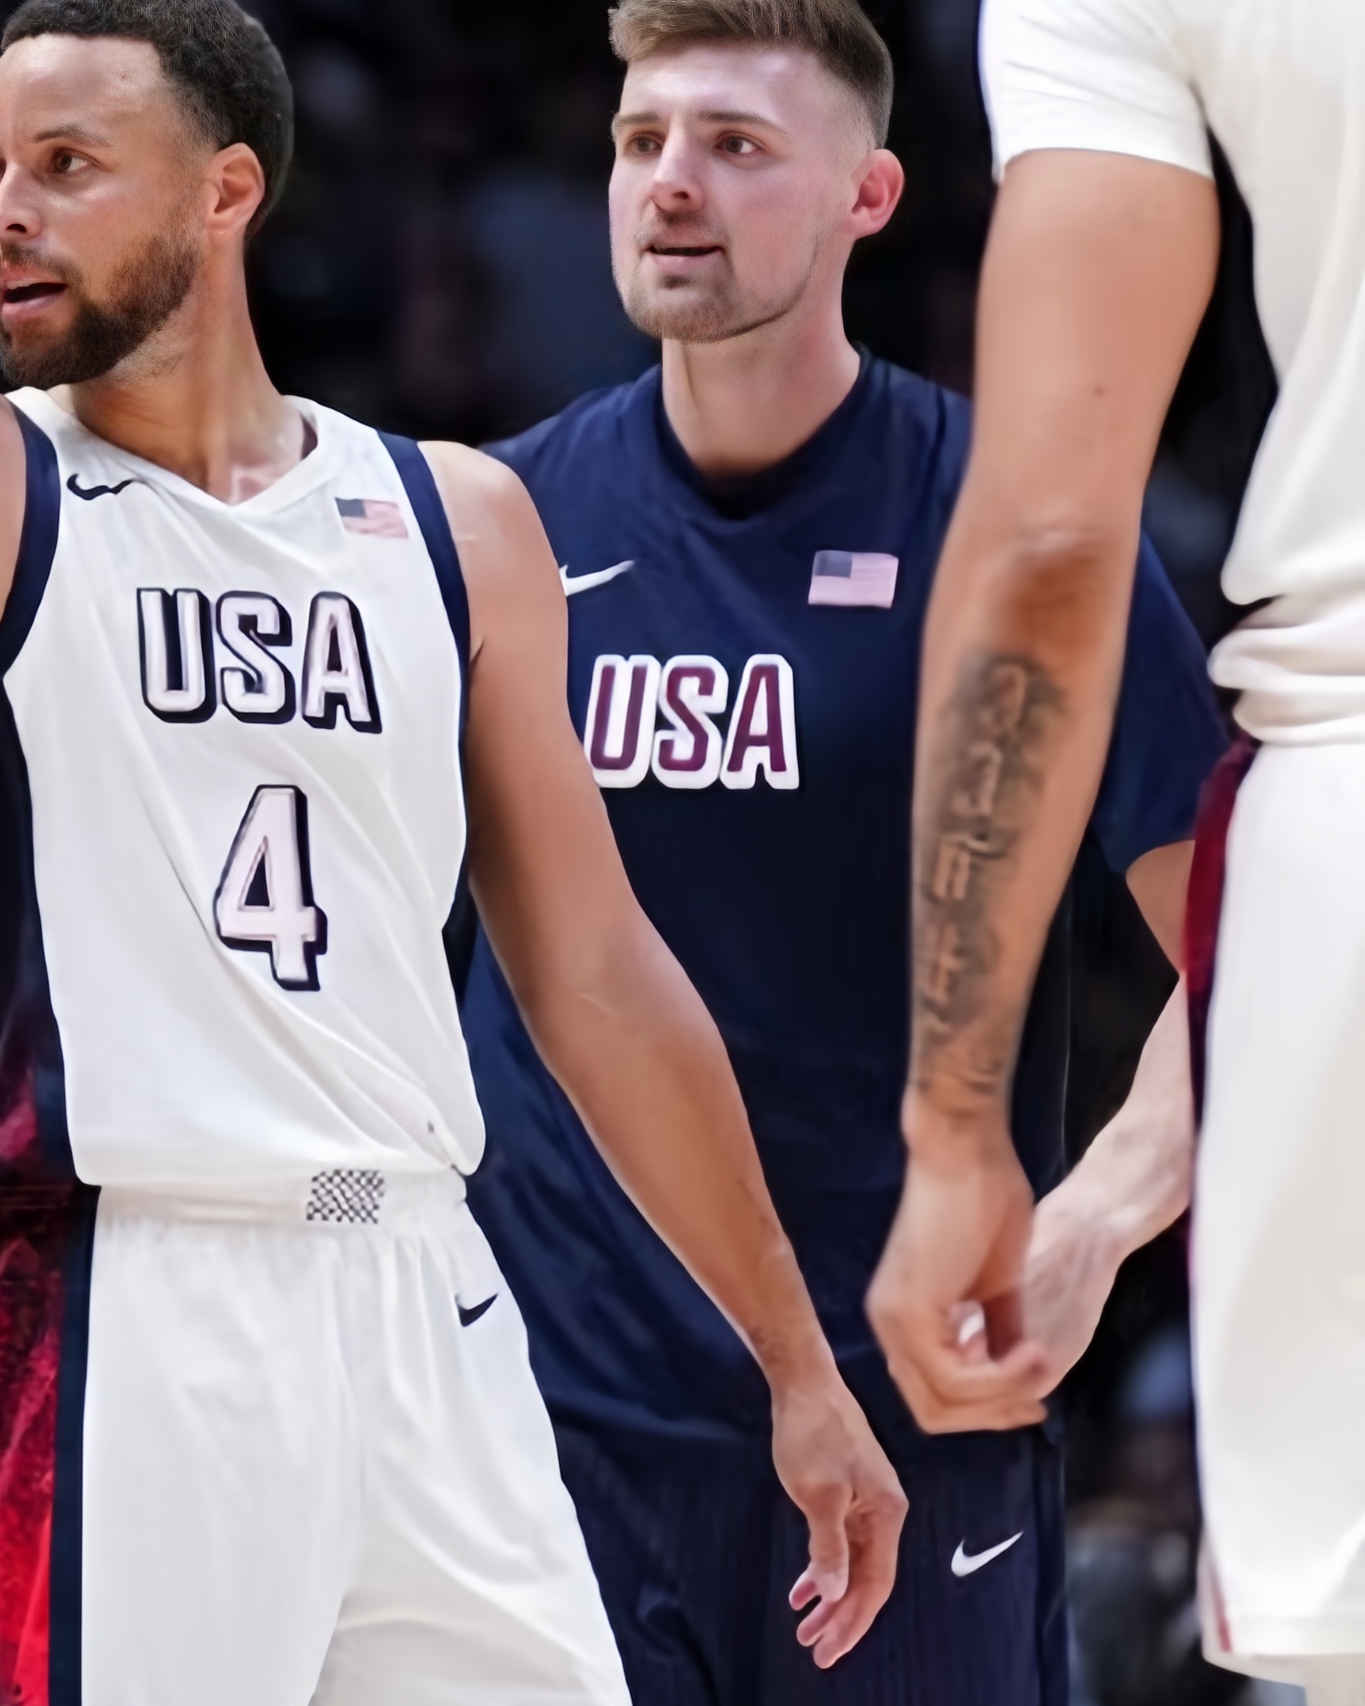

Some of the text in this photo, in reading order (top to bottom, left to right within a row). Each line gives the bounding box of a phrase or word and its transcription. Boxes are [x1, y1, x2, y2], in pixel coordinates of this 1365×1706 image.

[136, 587, 382, 733] USA
[584, 654, 800, 790] USA
[214, 784, 327, 991] 4
